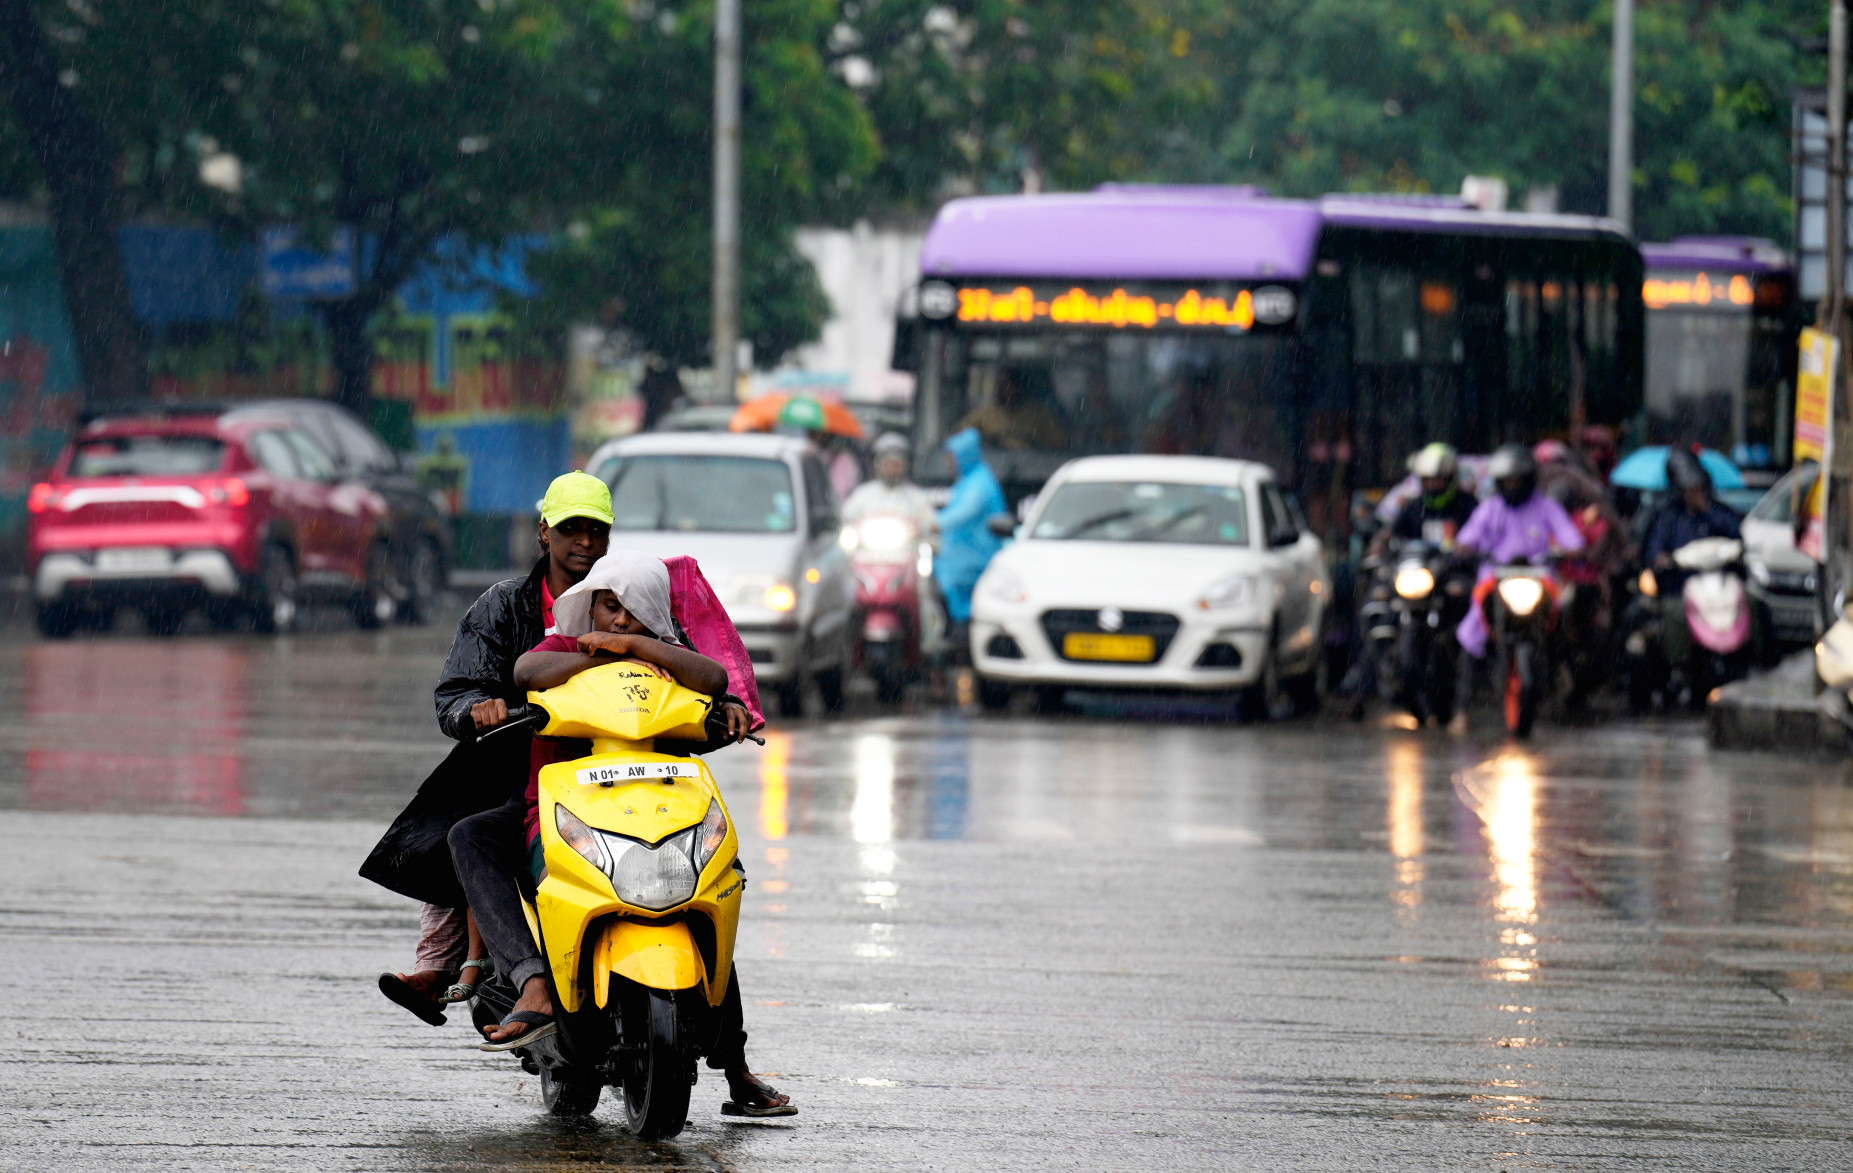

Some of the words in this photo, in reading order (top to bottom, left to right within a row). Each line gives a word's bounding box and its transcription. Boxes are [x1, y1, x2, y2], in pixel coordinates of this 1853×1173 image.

[589, 771, 598, 782] N
[600, 769, 614, 780] 01
[628, 766, 645, 777] AW
[665, 765, 679, 776] 10
